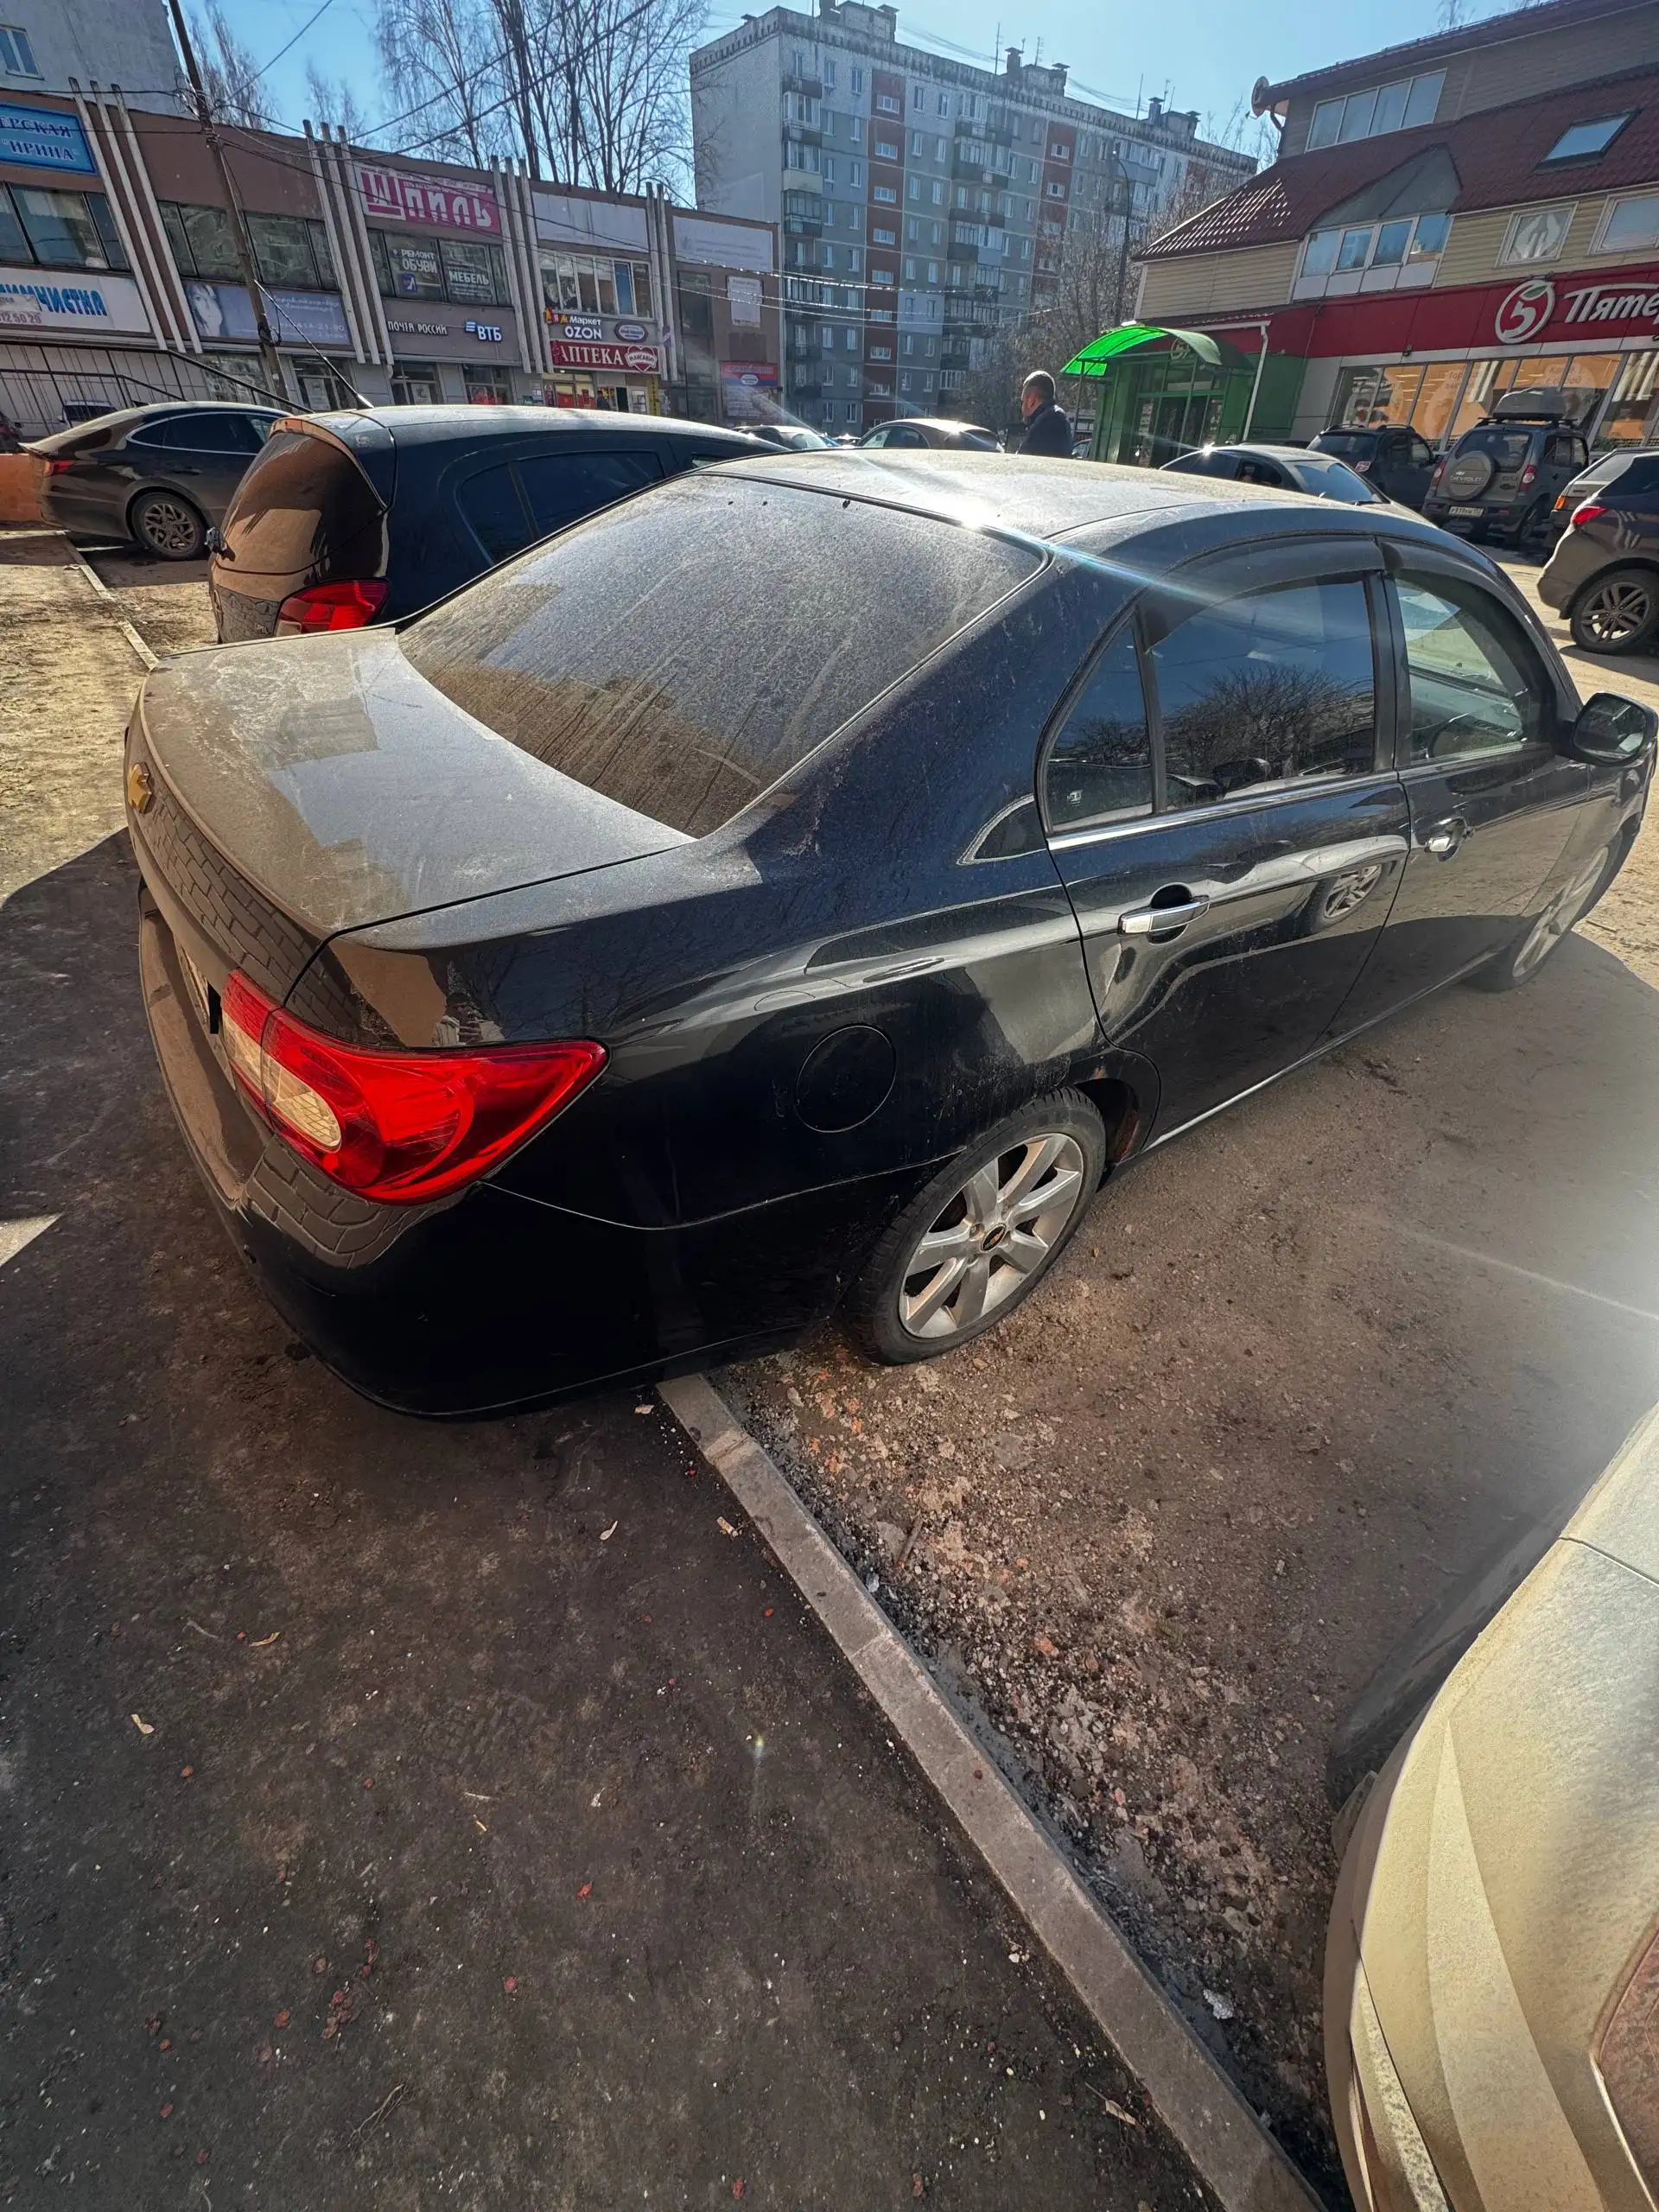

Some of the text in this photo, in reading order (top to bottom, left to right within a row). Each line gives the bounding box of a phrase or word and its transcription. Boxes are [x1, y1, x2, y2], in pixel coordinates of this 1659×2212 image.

[359, 172, 492, 227] ШПИЛЬ
[401, 249, 435, 259] РЕМОНТ
[402, 258, 438, 273] ОБУВИ
[448, 270, 490, 285] МЕБЕЛЬ
[0, 283, 107, 316] ЧИСТКА
[569, 315, 601, 326] Маркет
[1496, 300, 1536, 337] 5
[387, 321, 448, 335] ПОЧТА РОССИИ
[477, 326, 501, 341] ВТБ
[564, 325, 602, 340] OZON
